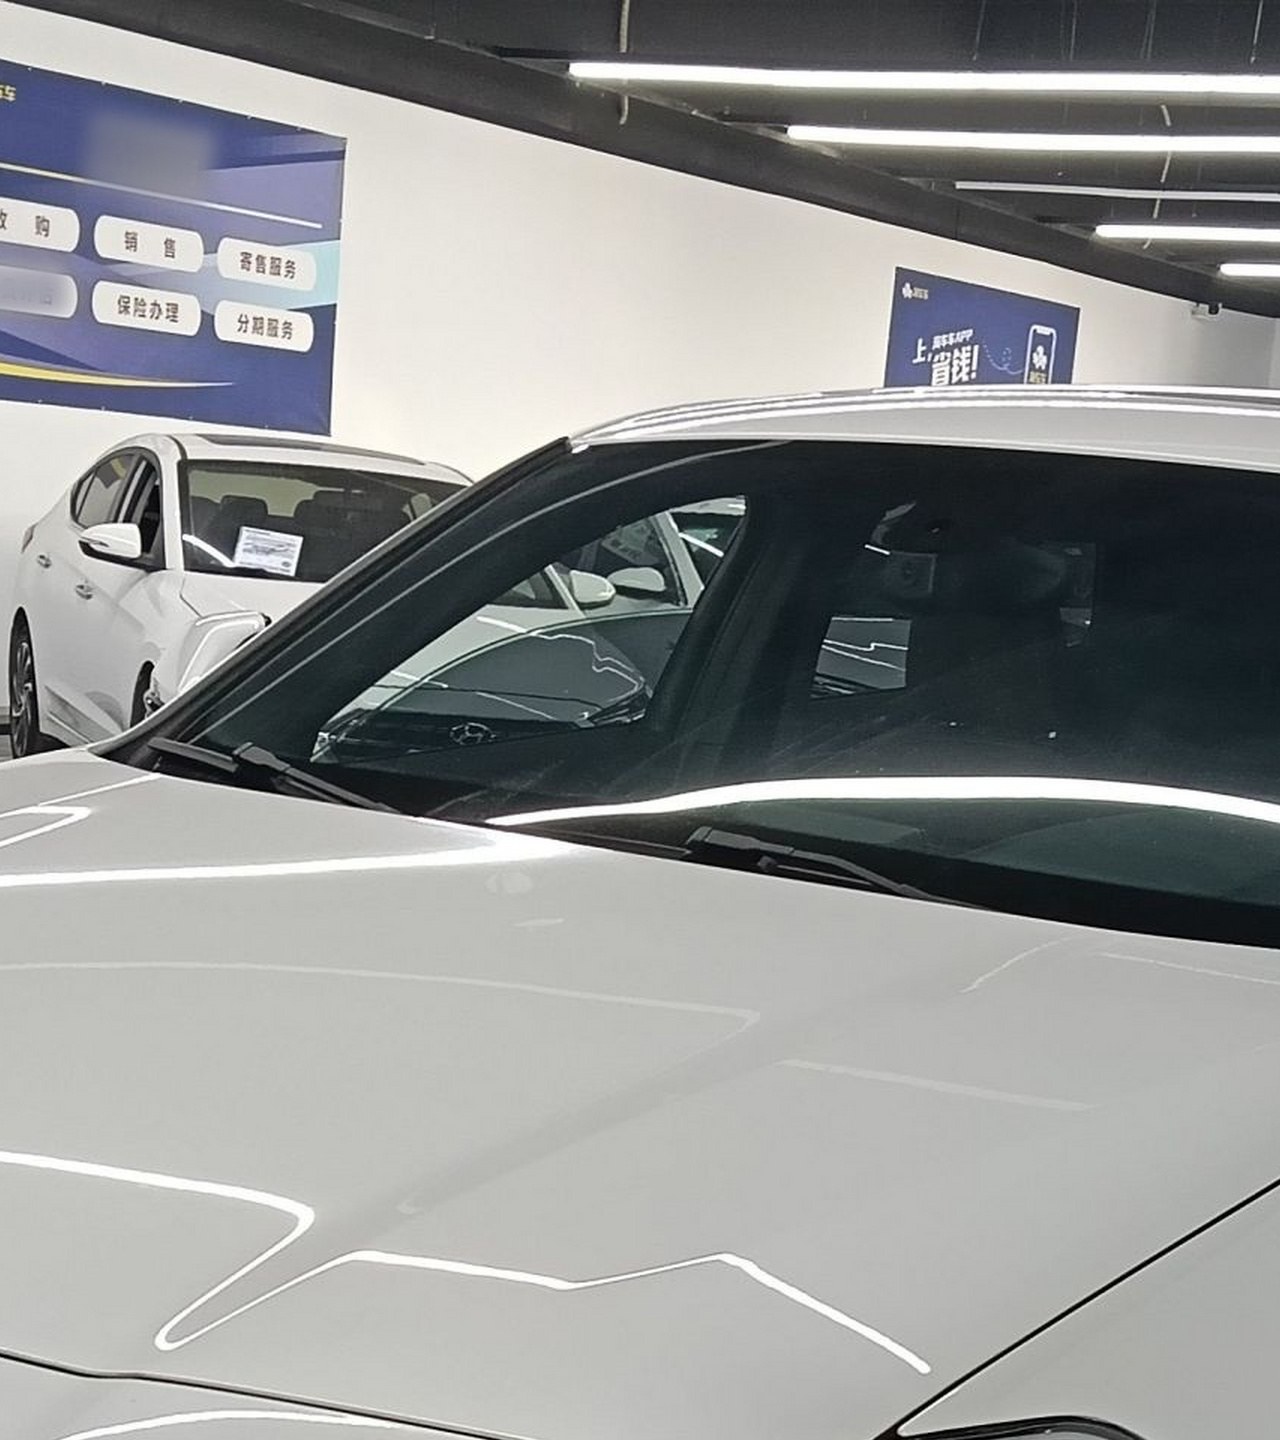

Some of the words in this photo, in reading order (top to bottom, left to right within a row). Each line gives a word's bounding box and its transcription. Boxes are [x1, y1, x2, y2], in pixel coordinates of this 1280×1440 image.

[240, 251, 297, 280] 寄售服务
[118, 295, 179, 324] 保险办理
[237, 314, 293, 340] 分期服务
